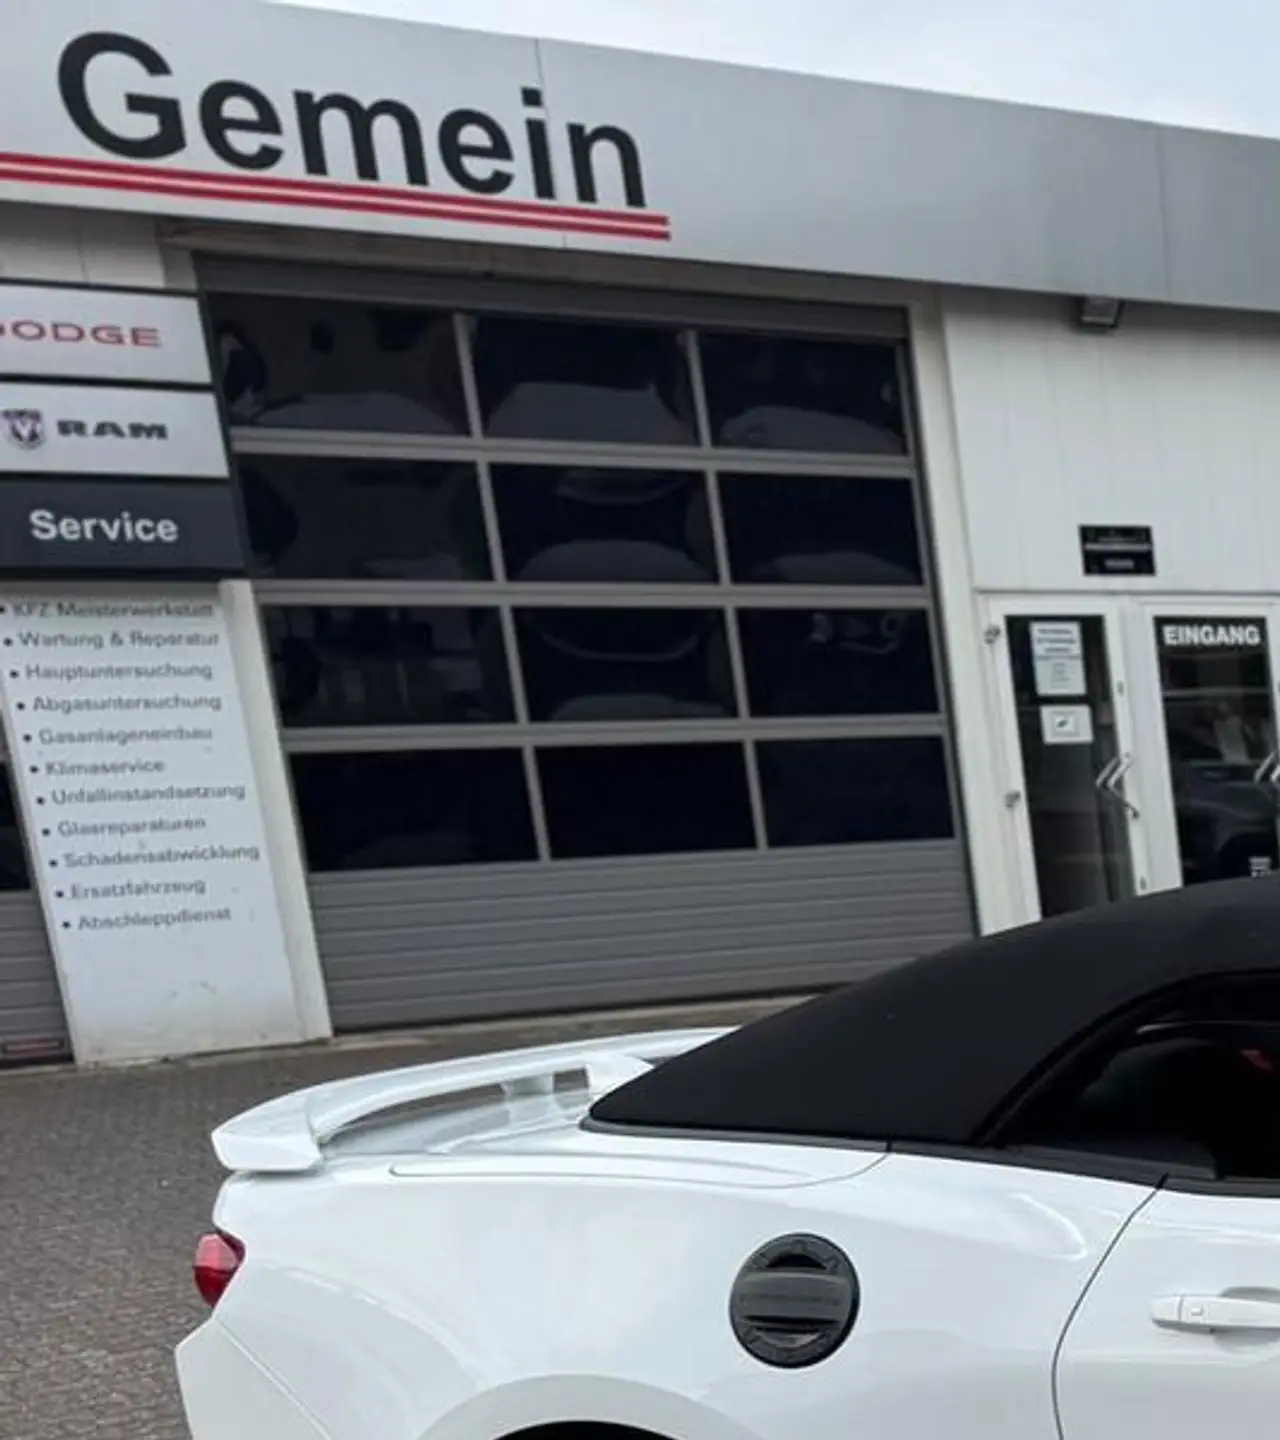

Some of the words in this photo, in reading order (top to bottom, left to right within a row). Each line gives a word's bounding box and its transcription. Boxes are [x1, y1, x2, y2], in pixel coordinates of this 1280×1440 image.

[57, 31, 647, 208] Gemein
[0, 319, 163, 348] ODGE
[57, 419, 169, 441] RAM
[29, 509, 180, 542] Service
[18, 631, 105, 650] Wartung
[109, 631, 124, 646] &
[130, 630, 219, 650] Reparatur
[1163, 625, 1262, 646] EINGANG
[25, 663, 213, 681] Hauptuntersuchung
[33, 695, 222, 714] Abgasuntersuchung
[45, 760, 166, 776] Klimaservice
[57, 817, 207, 838] Glasreparaturen
[63, 845, 261, 868] Schadensabwicklung
[71, 879, 207, 899] Ersatzfahrzeug
[78, 908, 232, 931] Abschleppdienst
